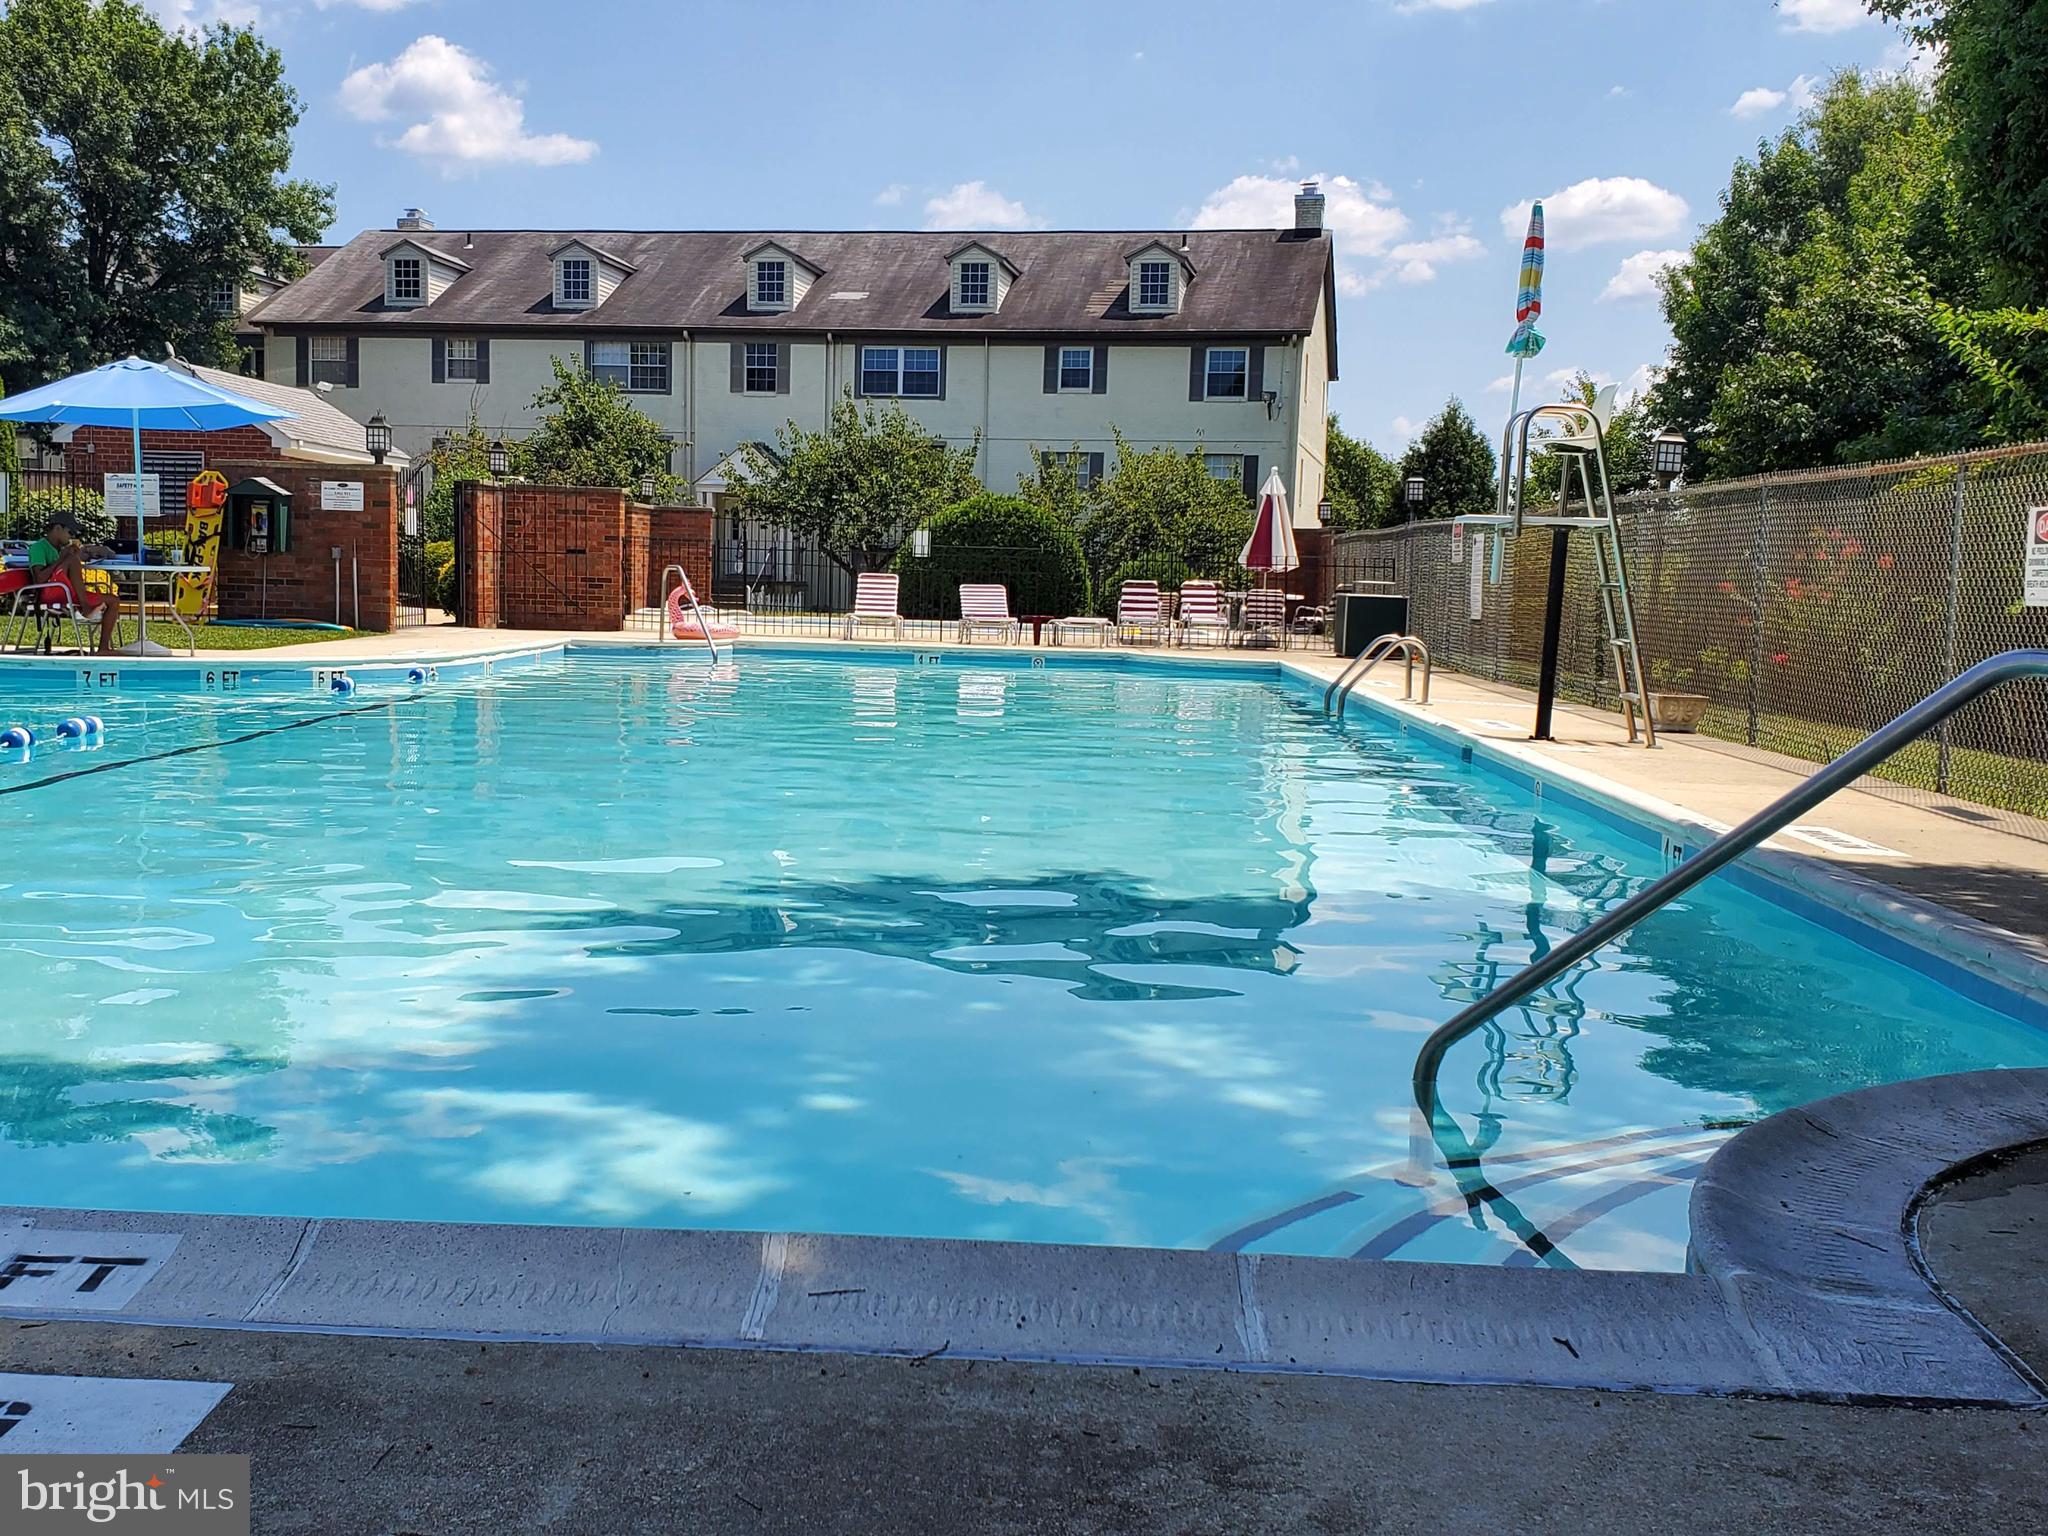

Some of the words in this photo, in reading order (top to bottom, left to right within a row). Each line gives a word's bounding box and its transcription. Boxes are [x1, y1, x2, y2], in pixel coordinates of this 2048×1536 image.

[929, 656, 940, 665] FT
[82, 670, 92, 688] 7
[99, 672, 117, 687] FT
[206, 671, 215, 685] 6
[0, 1255, 149, 1291] FT
